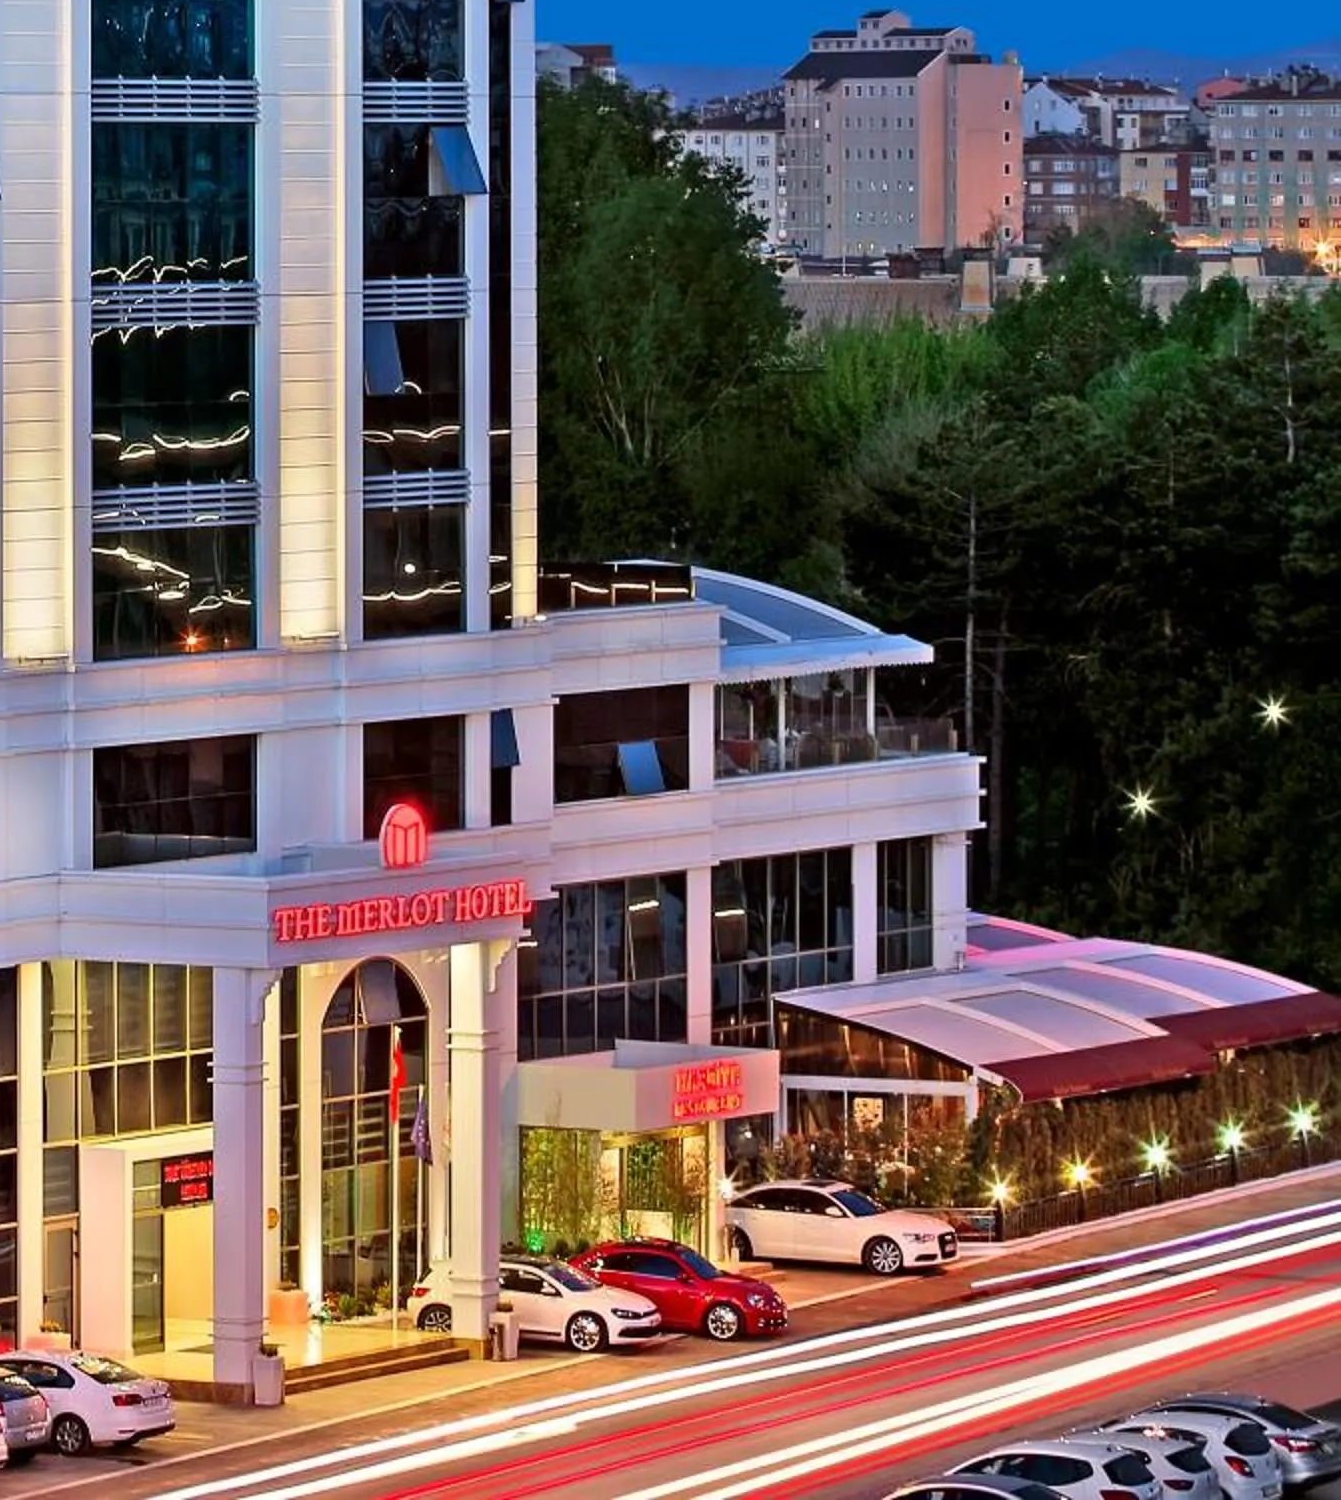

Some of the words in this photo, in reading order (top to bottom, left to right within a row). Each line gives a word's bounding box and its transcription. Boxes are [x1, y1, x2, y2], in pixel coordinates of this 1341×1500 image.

[275, 906, 332, 941] THE
[337, 890, 451, 936] MERLOT
[455, 880, 533, 923] HOTEL
